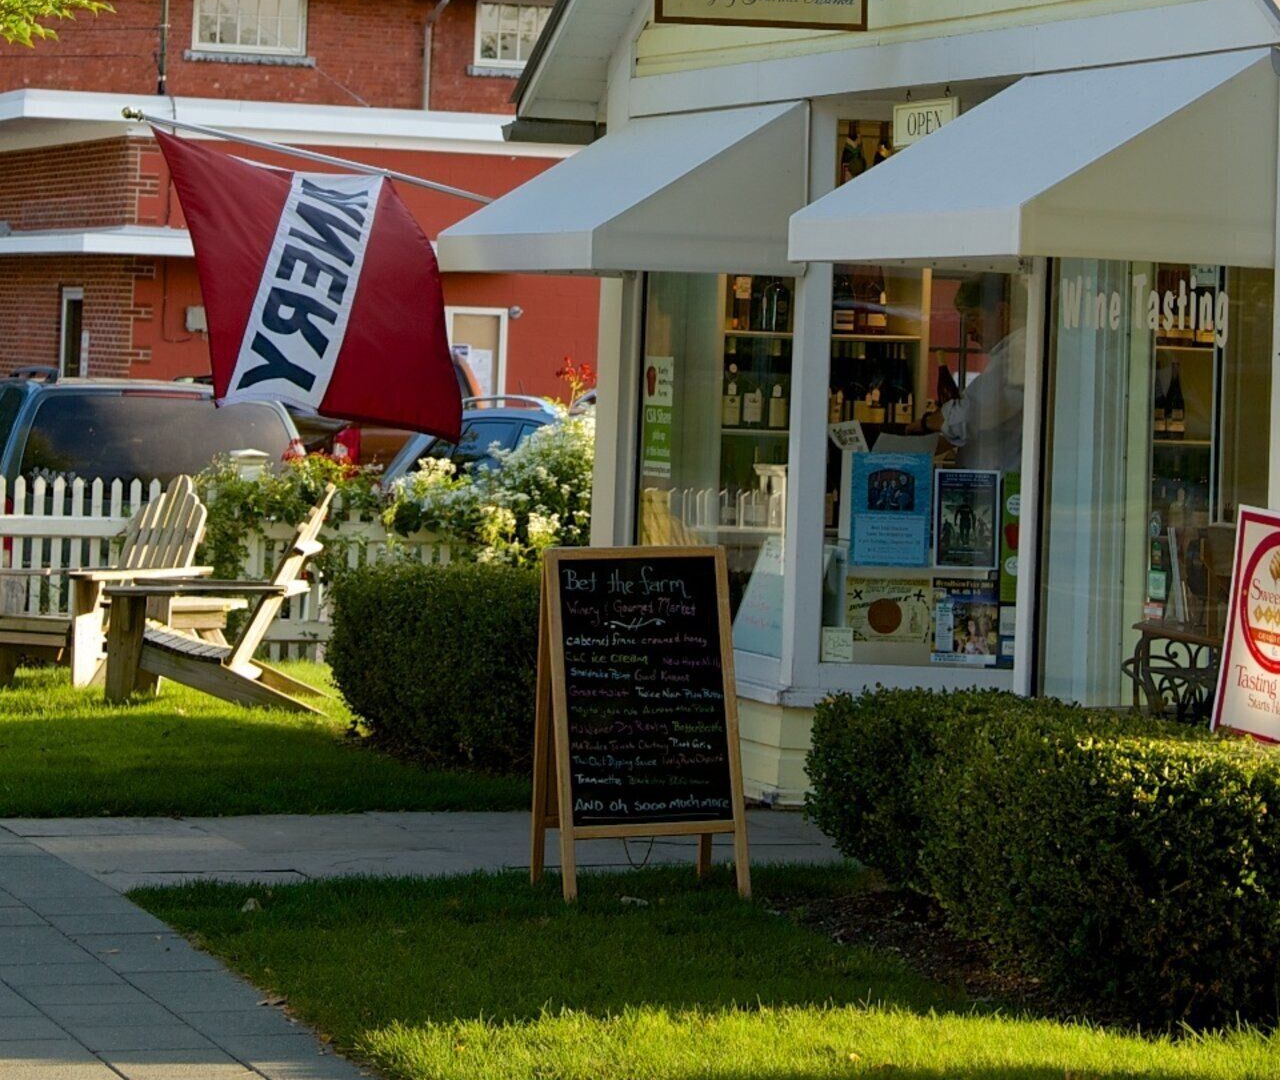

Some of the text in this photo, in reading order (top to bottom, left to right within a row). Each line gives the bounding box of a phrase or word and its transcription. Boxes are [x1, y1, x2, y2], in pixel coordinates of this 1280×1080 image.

[1062, 273, 1229, 348] Wine Tasting
[562, 568, 598, 593] Bet
[607, 568, 634, 595] the
[1236, 664, 1277, 700] Tasting
[1248, 693, 1270, 714] Starts
[575, 798, 604, 812] AND
